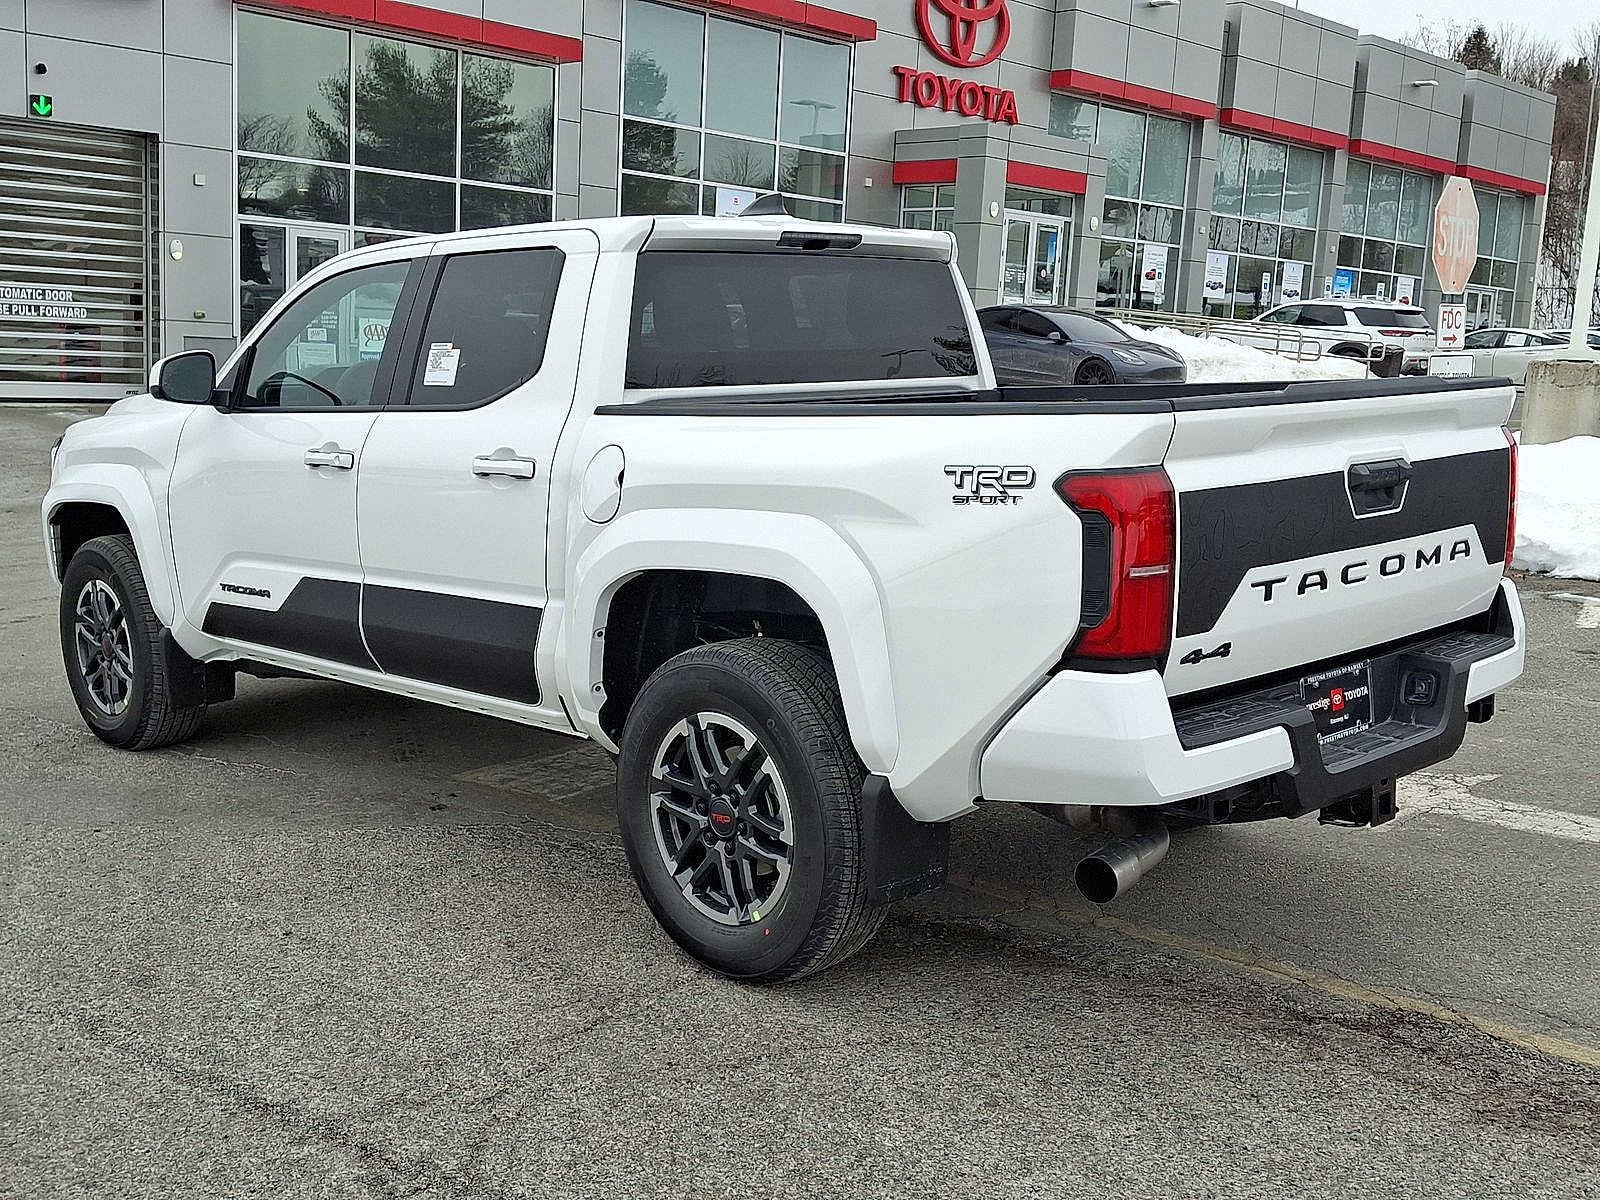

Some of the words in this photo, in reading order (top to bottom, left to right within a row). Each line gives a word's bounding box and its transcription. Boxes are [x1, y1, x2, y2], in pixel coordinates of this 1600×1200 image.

[893, 65, 1019, 125] TOYOTA
[1437, 215, 1476, 258] STOP
[45, 290, 73, 301] DOOR
[11, 304, 38, 317] PULL
[39, 306, 88, 318] FORWARD
[1441, 308, 1462, 330] FDC
[944, 464, 1037, 496] TRD
[952, 495, 1024, 506] SPORT
[1250, 539, 1471, 603] TACOMA
[219, 582, 271, 599] TACOMA
[1344, 686, 1369, 701] TOYOTA
[711, 812, 731, 824] TRD
